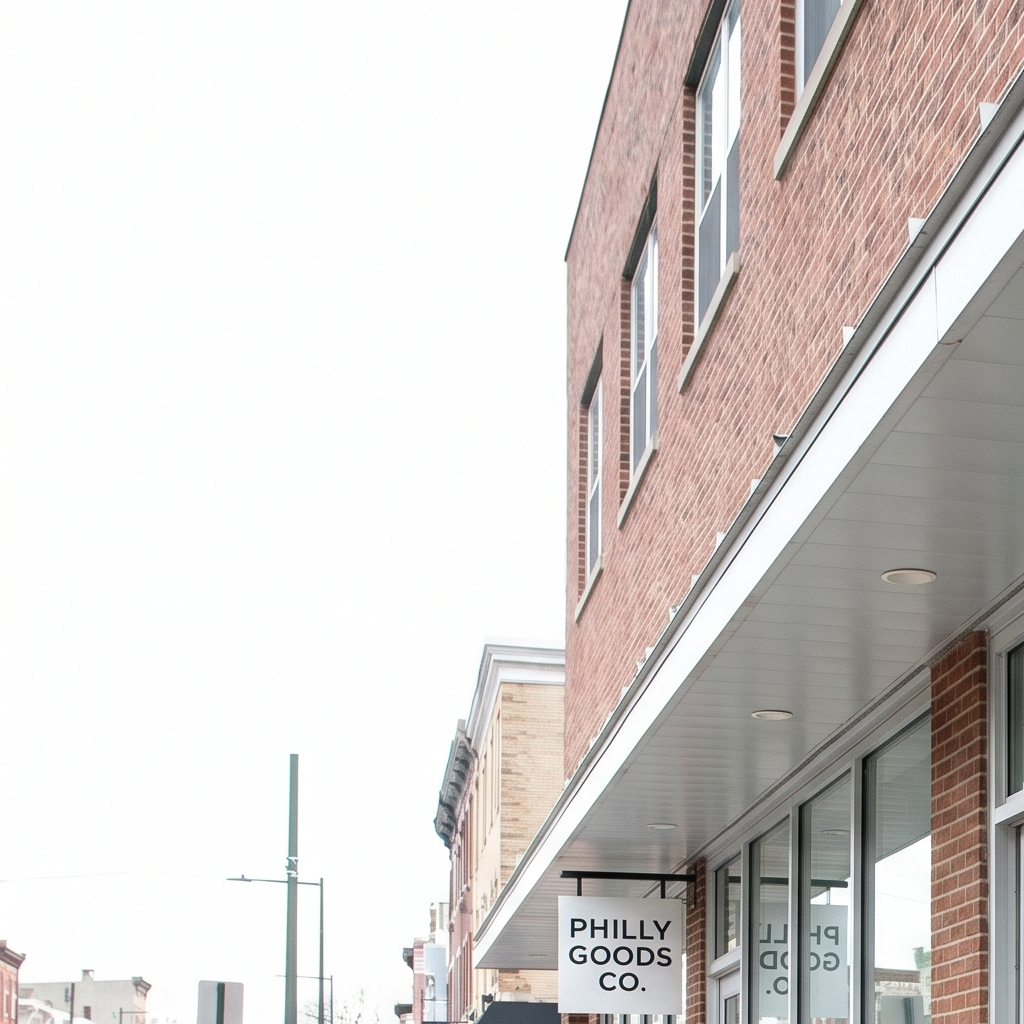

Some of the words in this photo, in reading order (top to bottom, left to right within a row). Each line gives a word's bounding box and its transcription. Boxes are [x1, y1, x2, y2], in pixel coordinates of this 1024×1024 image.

[570, 918, 672, 940] PHILLY
[568, 945, 672, 967] GOODS
[598, 971, 646, 991] CO.
